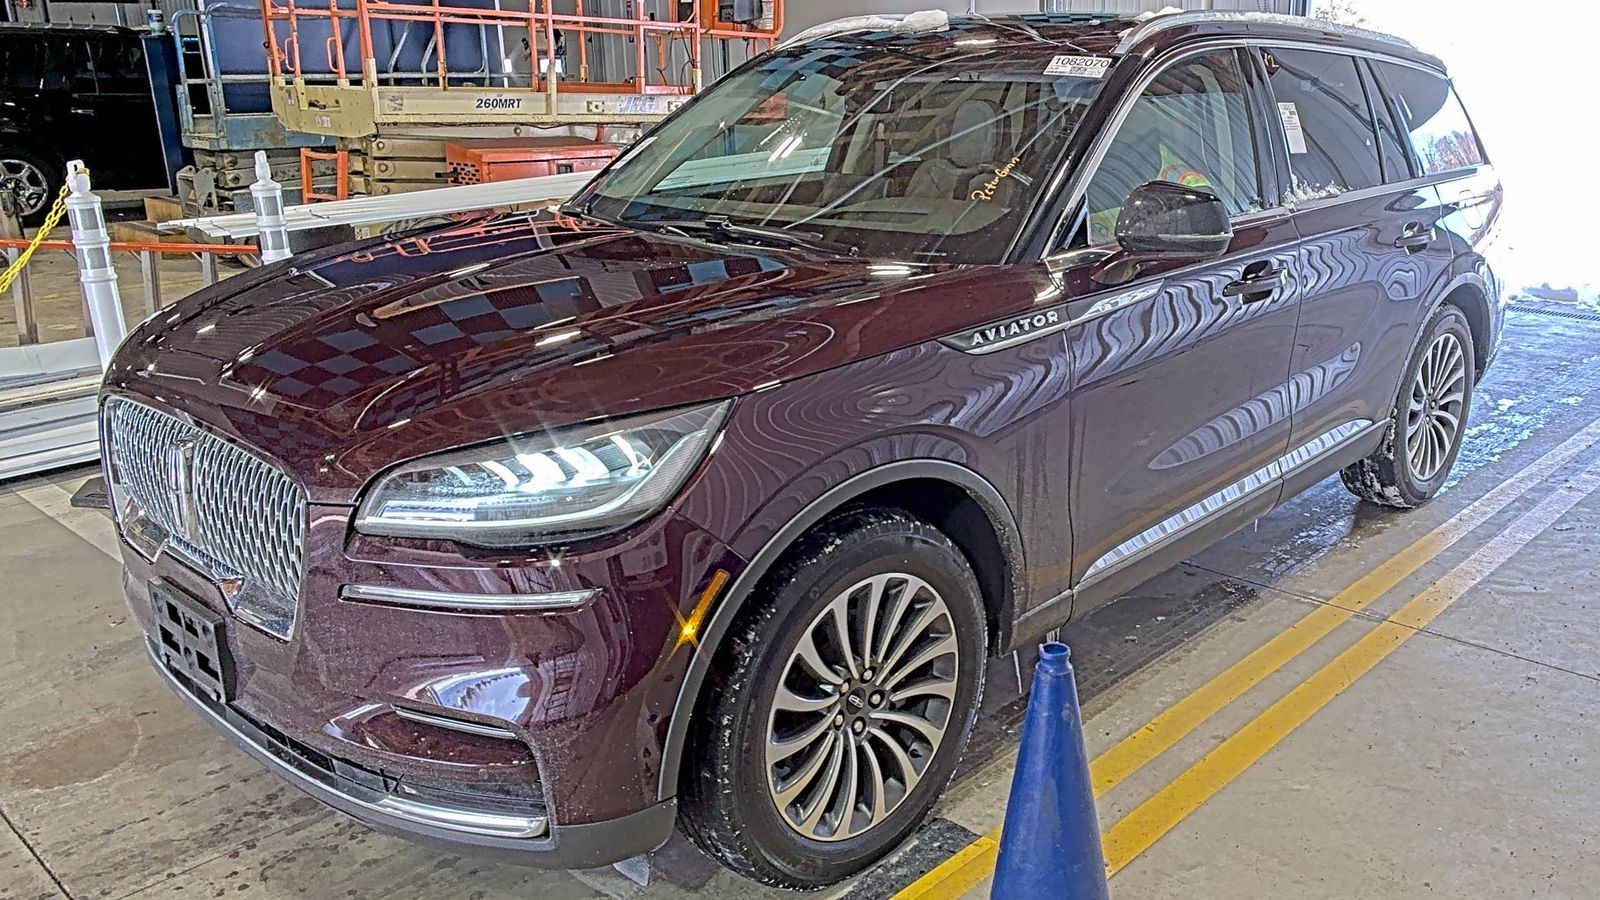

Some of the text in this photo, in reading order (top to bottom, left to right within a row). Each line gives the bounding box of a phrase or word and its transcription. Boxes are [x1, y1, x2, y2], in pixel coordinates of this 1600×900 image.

[1055, 57, 1110, 68] 1082070
[475, 98, 522, 109] 260MRT
[971, 310, 1059, 346] AVIATOR
